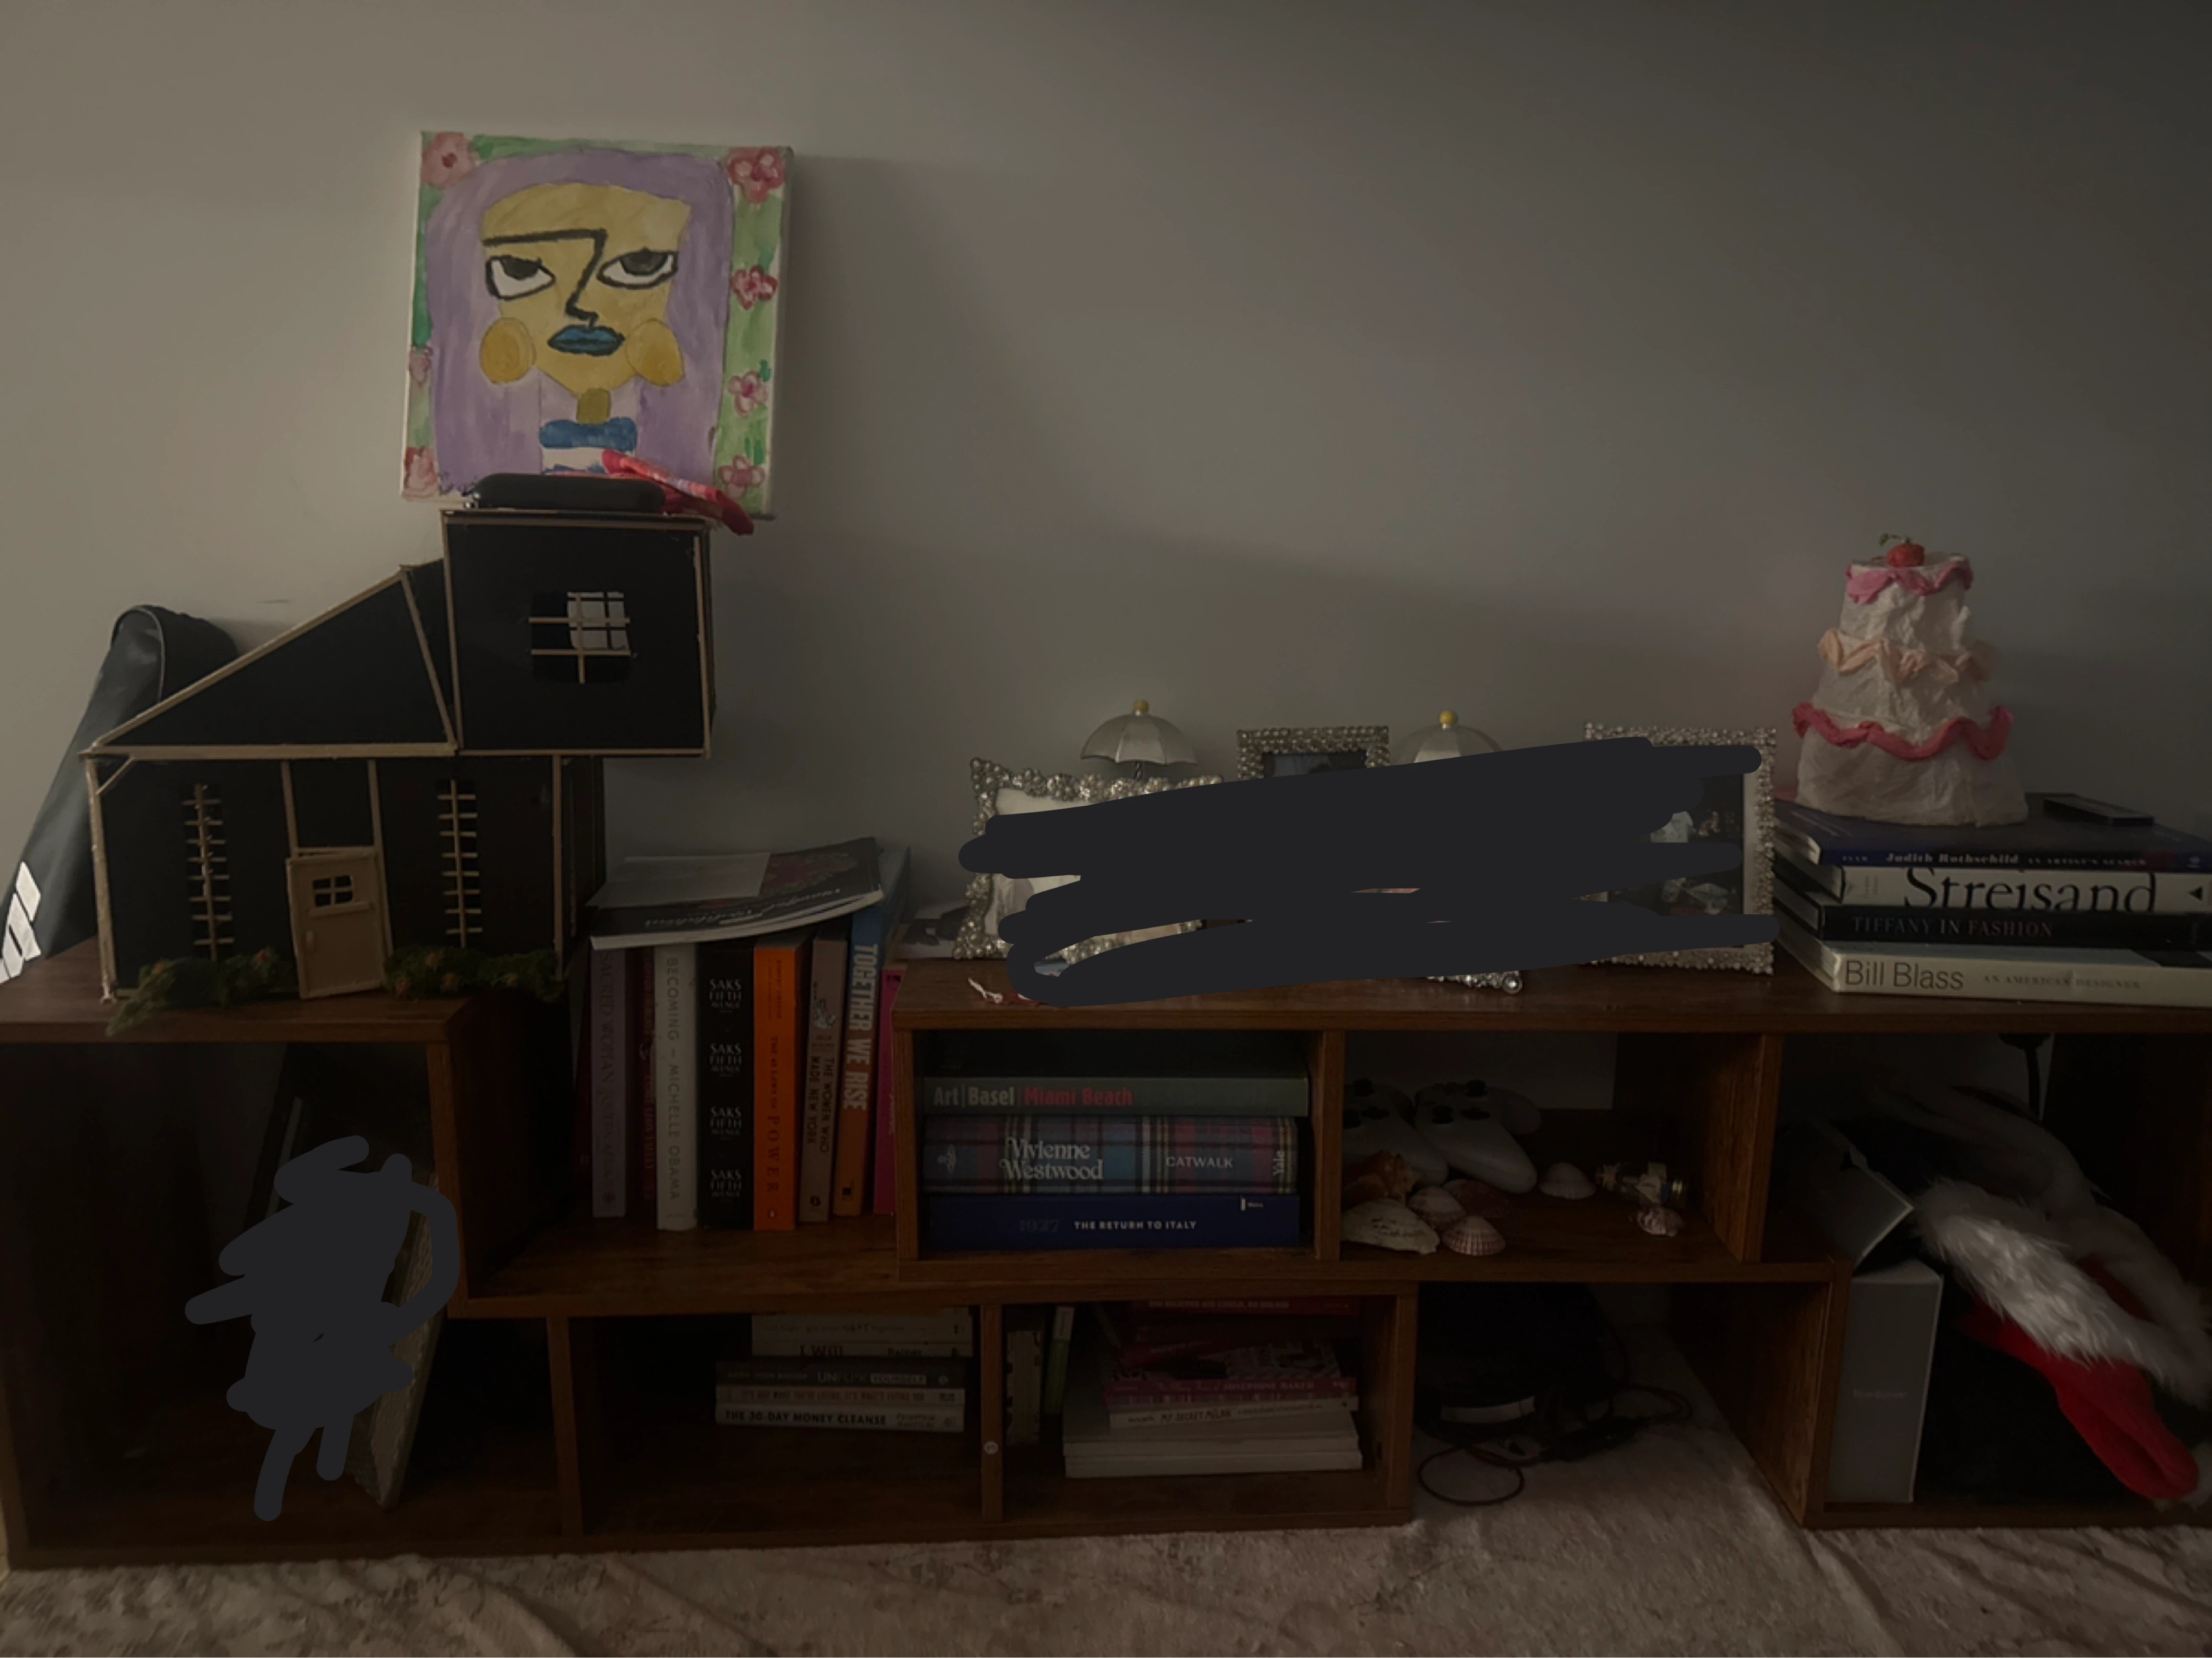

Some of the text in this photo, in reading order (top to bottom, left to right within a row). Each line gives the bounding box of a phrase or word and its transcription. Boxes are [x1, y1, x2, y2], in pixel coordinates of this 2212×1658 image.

[1885, 852, 1933, 863] Judith
[1904, 867, 2157, 913] Streisand
[1852, 916, 2053, 938] TIFFANY IN FASHION
[709, 978, 742, 991] SAKS
[1845, 960, 1964, 991] Bill Blass
[667, 957, 680, 1041] BECOMING
[843, 943, 879, 1111] TOGETHER WE RISE
[601, 1019, 615, 1084] WOMAN
[709, 1043, 742, 1054] SAKS
[770, 1036, 779, 1055] THE
[823, 1057, 836, 1078] THE
[770, 1070, 778, 1095] LAWS
[667, 1063, 680, 1138] MICHELLE
[806, 1056, 821, 1145] MADE NEW YORK
[821, 1082, 833, 1122] WOMEN
[933, 1086, 1135, 1106] Art Basel Miami Beach
[709, 1106, 742, 1117] SAKS
[819, 1126, 830, 1153] WHO
[1005, 1136, 1091, 1159] Vivienne
[766, 1115, 780, 1193] POWER
[1165, 1156, 1234, 1169] CATWALK
[1272, 1149, 1285, 1176] Yale
[668, 1145, 681, 1200] OBAMA
[709, 1168, 742, 1180] SAKS
[998, 1158, 1104, 1180] Westwood
[1074, 1220, 1097, 1230] THE
[1099, 1220, 1144, 1230] RETURN
[1146, 1220, 1163, 1230] TO
[1165, 1220, 1197, 1230] ITALY
[799, 1344, 844, 1358] I Will
[725, 1410, 745, 1420] THE
[793, 1412, 833, 1424] MONEY
[837, 1413, 887, 1426] CLEANSE
